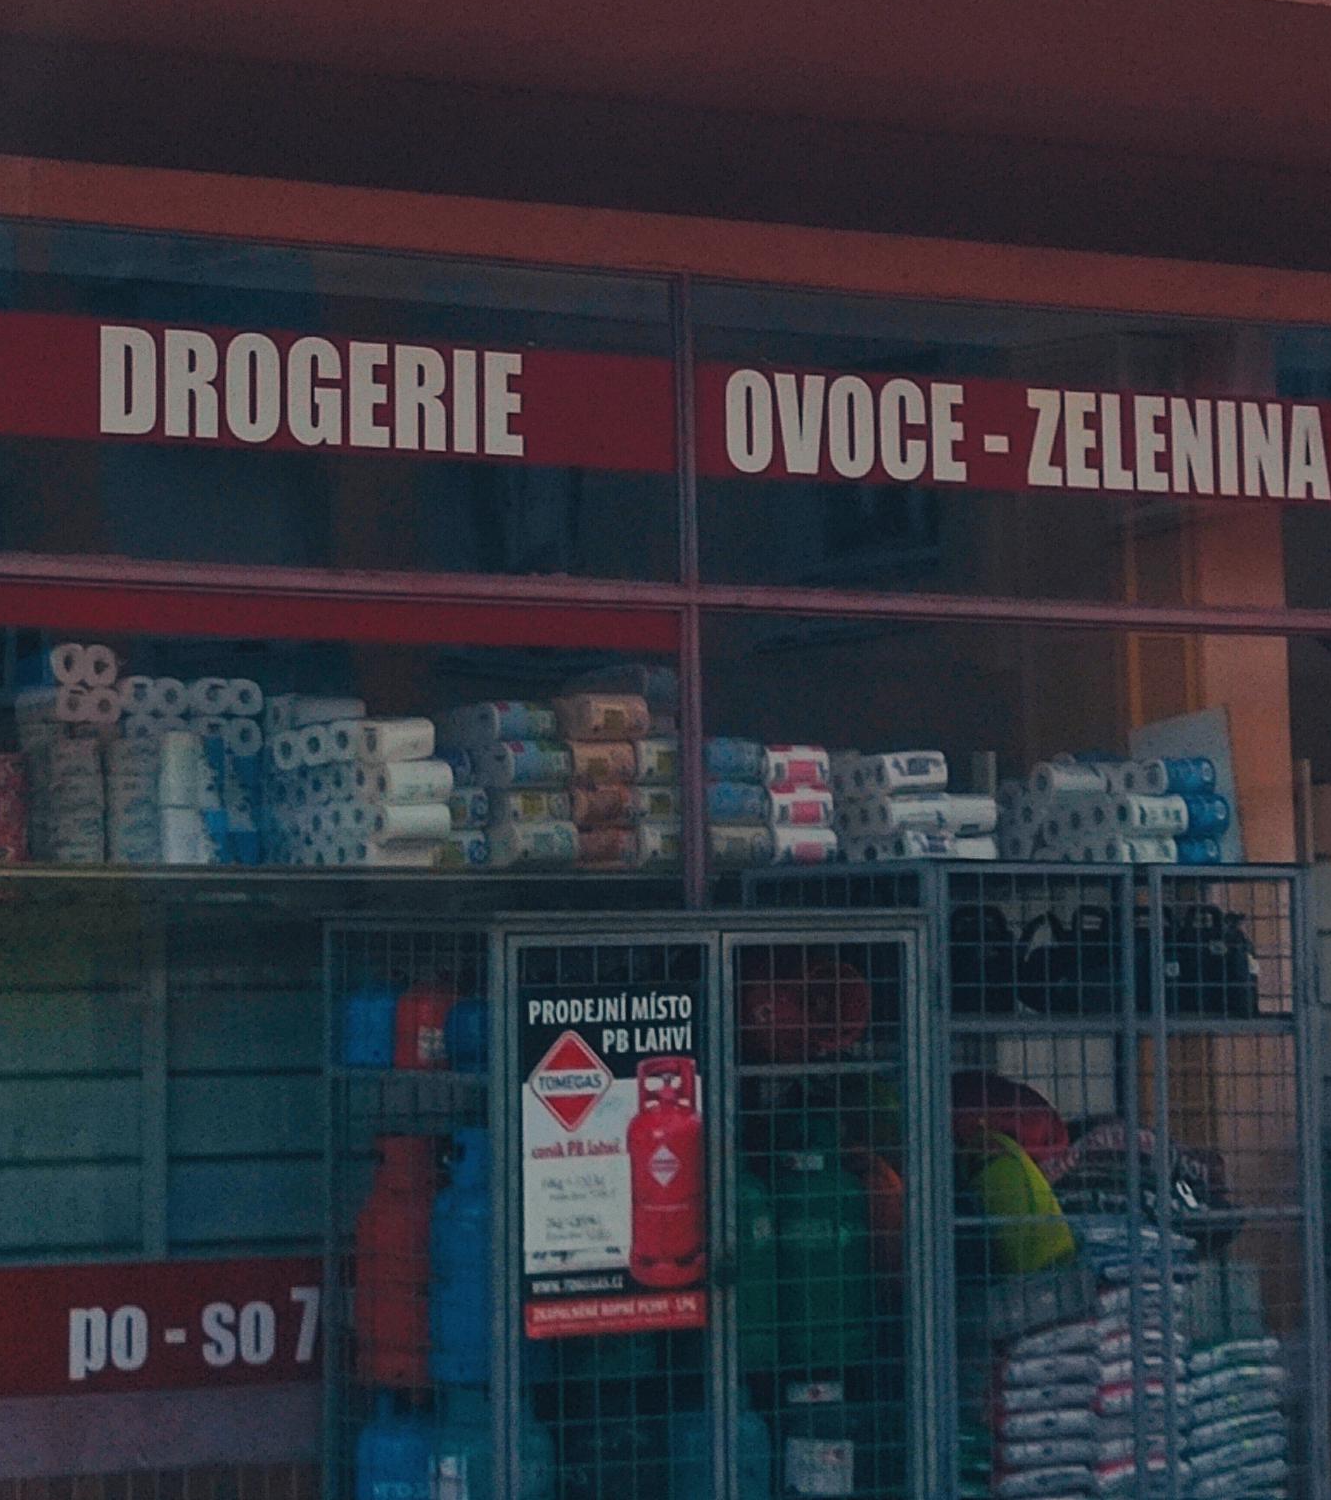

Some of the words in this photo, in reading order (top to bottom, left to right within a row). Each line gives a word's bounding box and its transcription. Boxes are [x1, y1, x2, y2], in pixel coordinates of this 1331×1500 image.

[100, 325, 524, 457] DROGERIE
[725, 369, 967, 482] OVOCE
[1026, 388, 1331, 500] ZELENINA
[528, 992, 627, 1025] PRODEJNÍ
[631, 991, 692, 1021] MÍSTO
[602, 1028, 629, 1054] PB
[634, 1021, 692, 1053] LAHVÍ
[538, 1074, 602, 1092] TOMEGAS
[69, 1304, 148, 1381] po
[201, 1300, 276, 1367] so
[290, 1285, 320, 1362] 7
